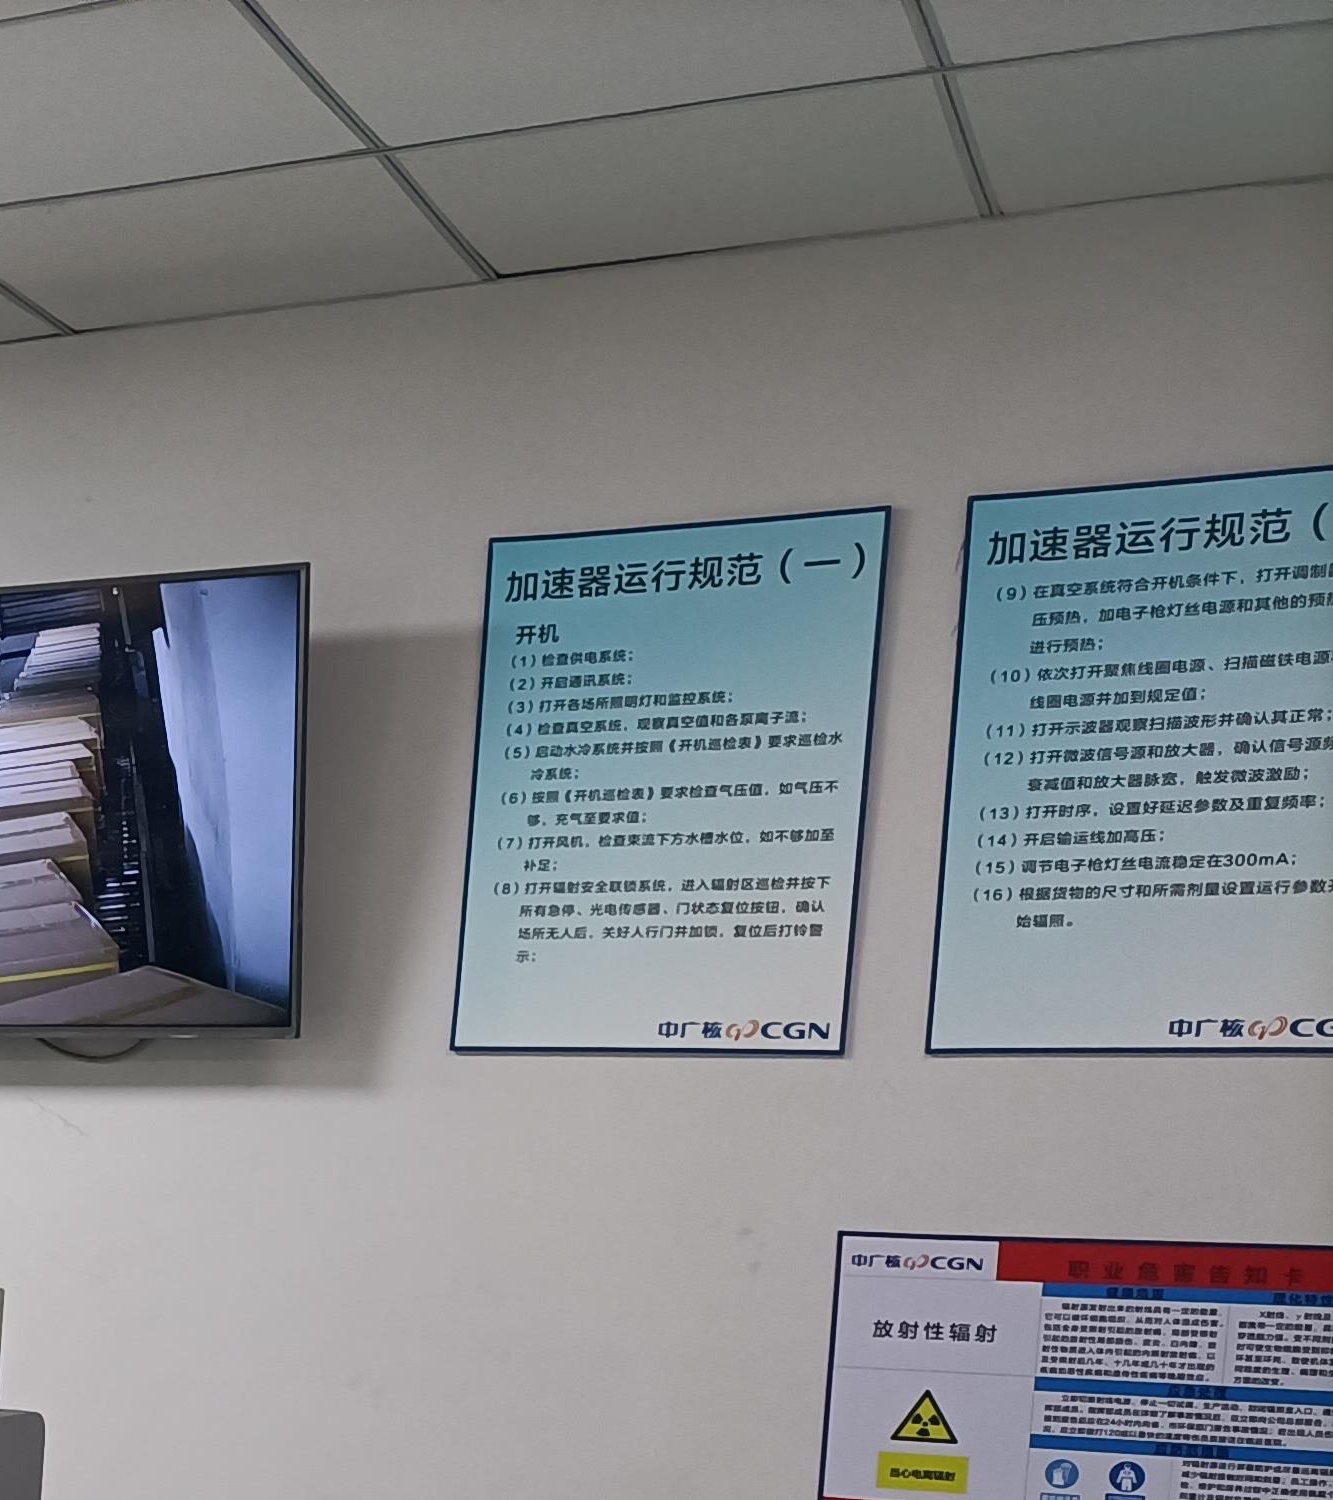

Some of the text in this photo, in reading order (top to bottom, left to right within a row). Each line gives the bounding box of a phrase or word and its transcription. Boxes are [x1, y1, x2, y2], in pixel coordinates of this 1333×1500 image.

[504, 542, 866, 603] 加速器运行规范（一）
[515, 623, 559, 645] 开机
[658, 1021, 722, 1040] 中广核
[760, 1021, 830, 1041] CGN
[1168, 1018, 1246, 1039] 中广核
[851, 1254, 901, 1269] 中广核
[930, 1256, 984, 1271] CGN
[872, 1319, 997, 1343] 放射性辐射
